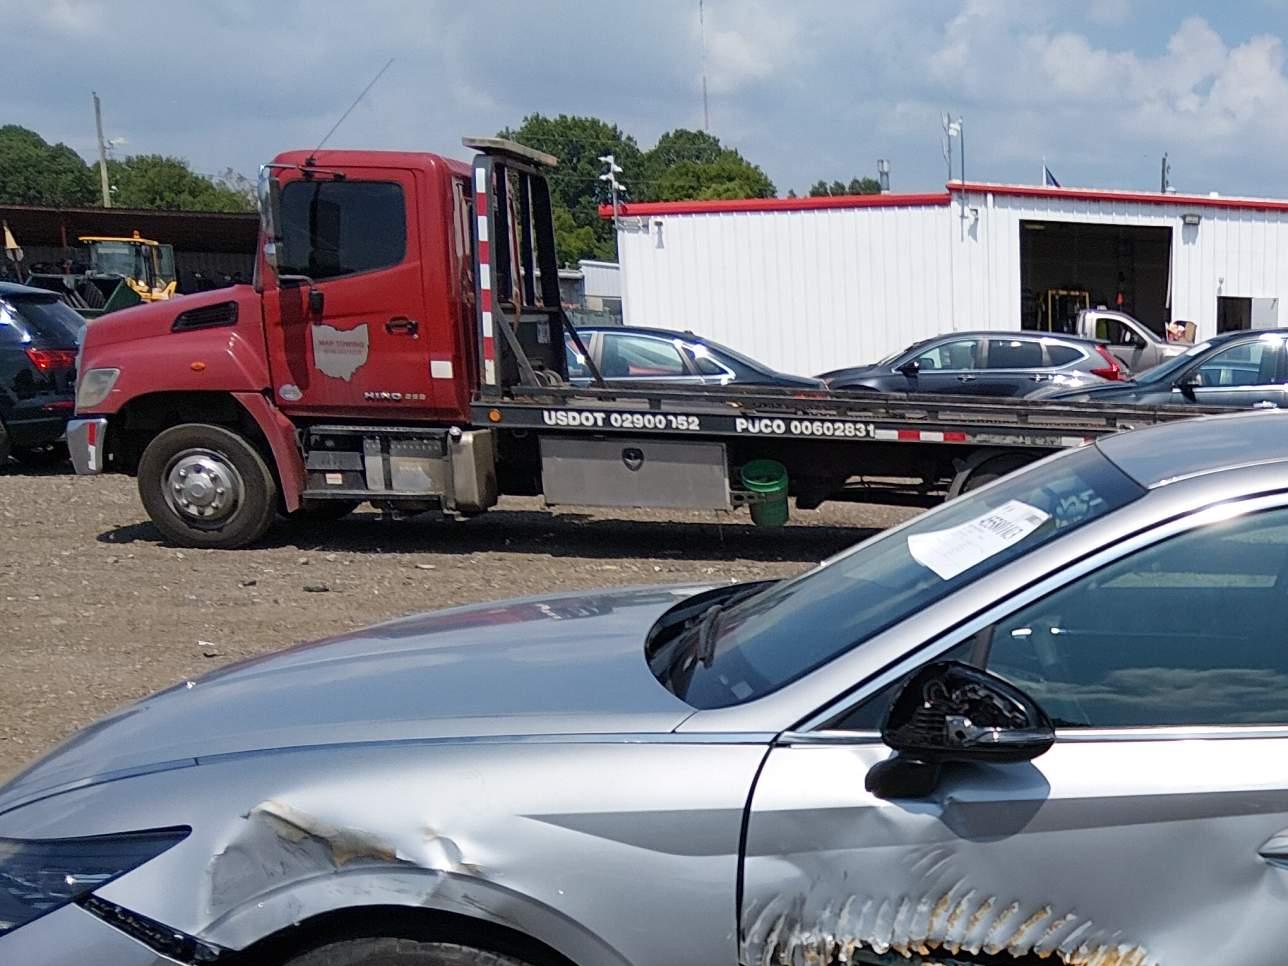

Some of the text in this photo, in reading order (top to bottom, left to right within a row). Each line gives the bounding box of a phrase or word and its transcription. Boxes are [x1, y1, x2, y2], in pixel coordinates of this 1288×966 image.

[363, 391, 403, 401] HINO
[543, 410, 607, 427] USDOT
[735, 417, 876, 438] PUCO 00602831
